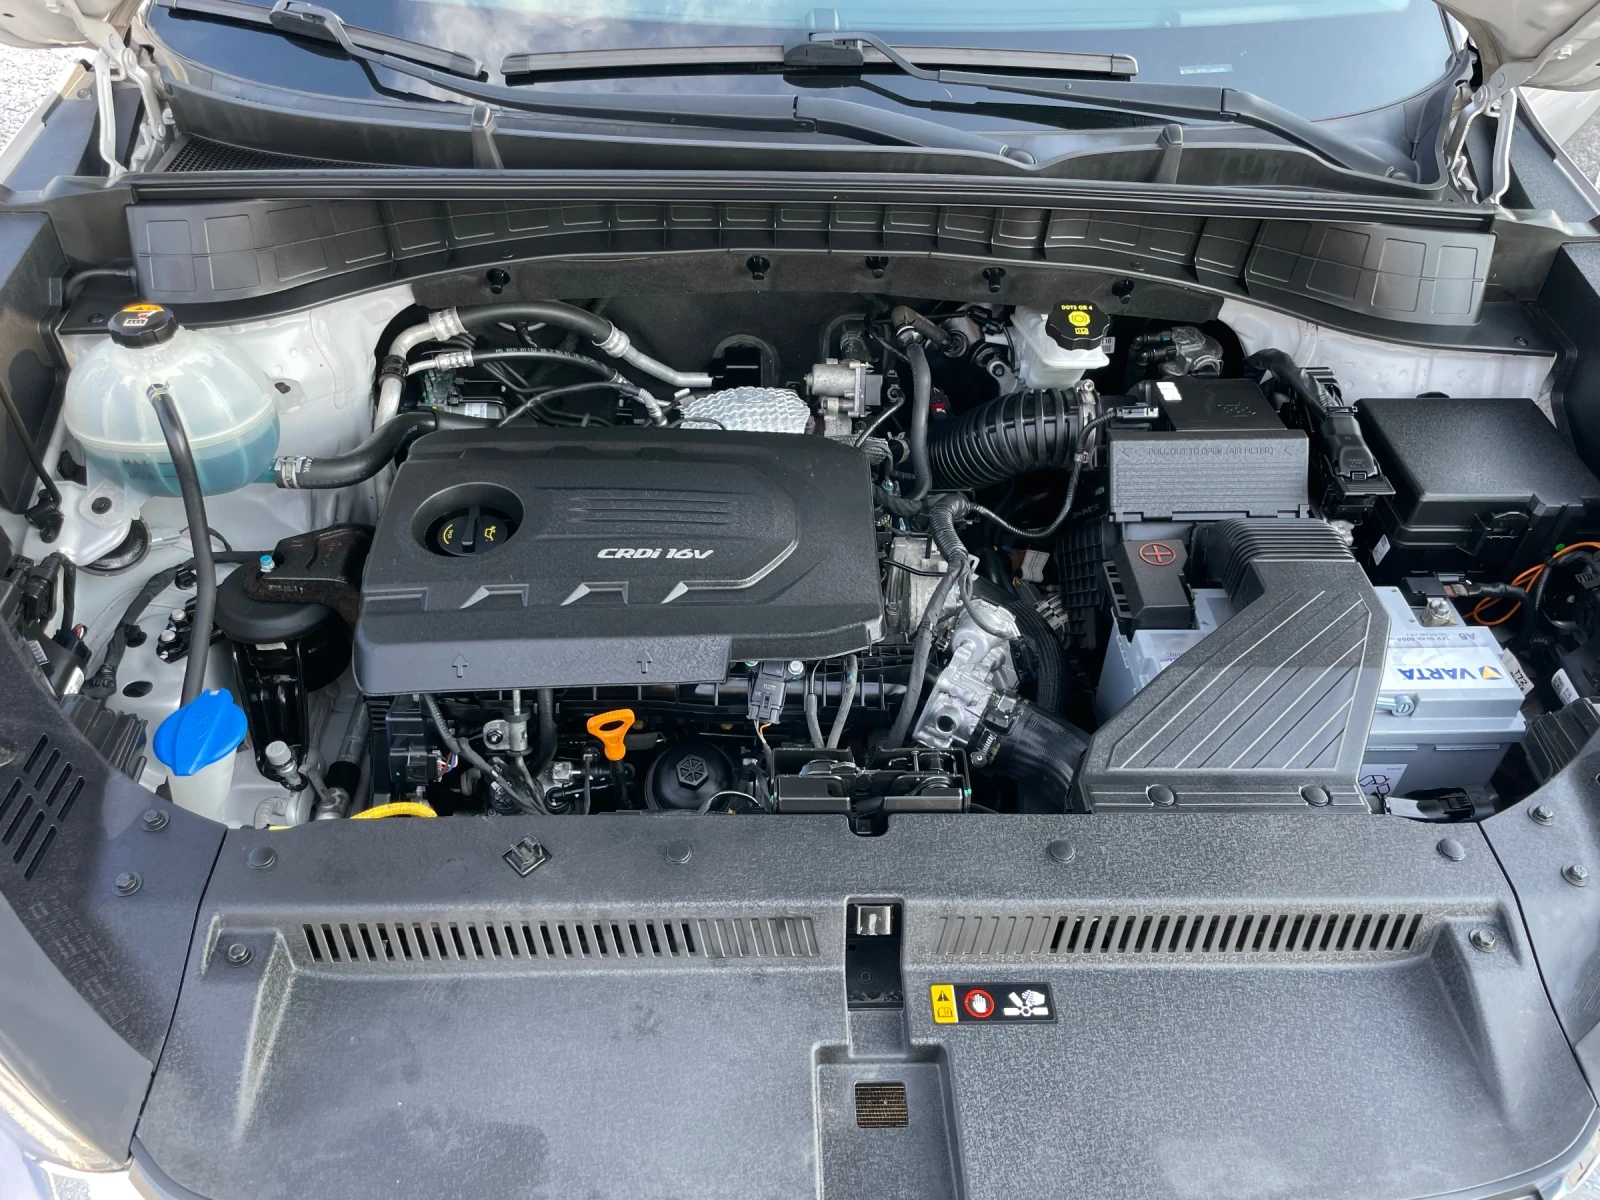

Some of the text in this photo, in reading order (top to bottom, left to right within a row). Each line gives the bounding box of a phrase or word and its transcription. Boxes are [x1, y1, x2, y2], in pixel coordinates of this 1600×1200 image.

[1149, 447, 1168, 455] PULL
[1170, 447, 1186, 455] OUT
[1189, 447, 1200, 455] TO
[1201, 447, 1222, 455] OPEN
[597, 548, 714, 559] CRDi 16V
[1396, 667, 1478, 680] VARTA
[1514, 669, 1528, 687] T72
